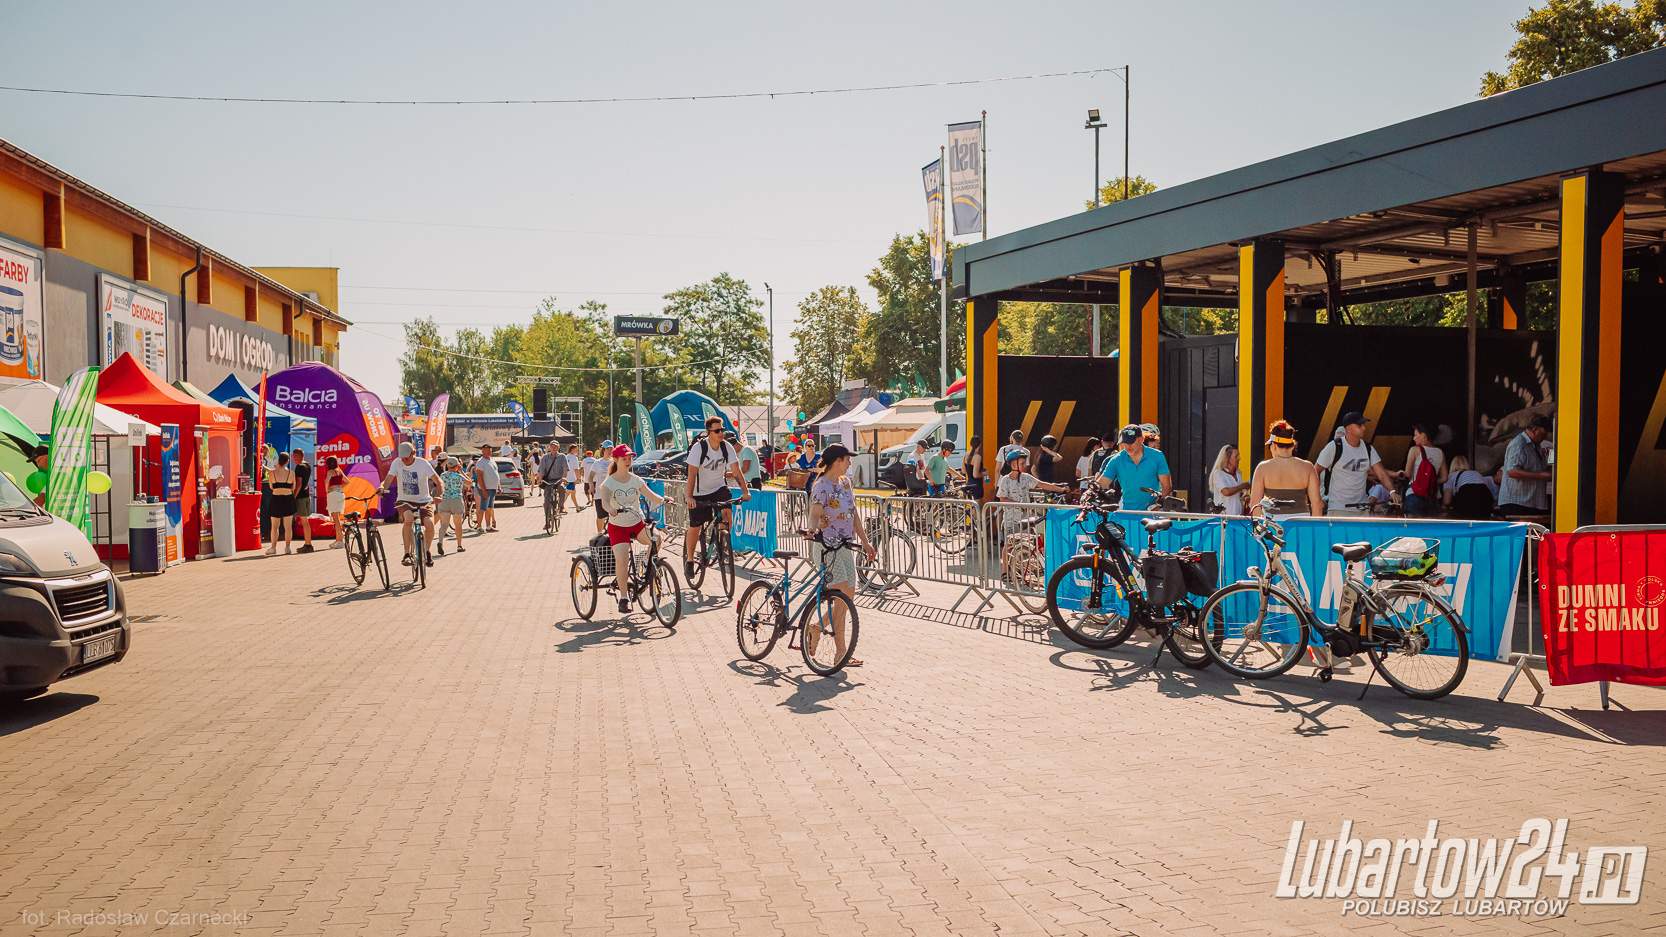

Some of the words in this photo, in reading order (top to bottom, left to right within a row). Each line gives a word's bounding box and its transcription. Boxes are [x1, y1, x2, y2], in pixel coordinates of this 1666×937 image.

[131, 303, 164, 326] DEKORACJE
[621, 319, 654, 330] MRÓWKA
[209, 323, 235, 362] DOM
[275, 384, 338, 403] Balcia
[274, 402, 337, 410] insurance
[1558, 584, 1626, 608] DUMNI
[1558, 609, 1579, 632] ZE
[1584, 607, 1660, 632] SMAKU
